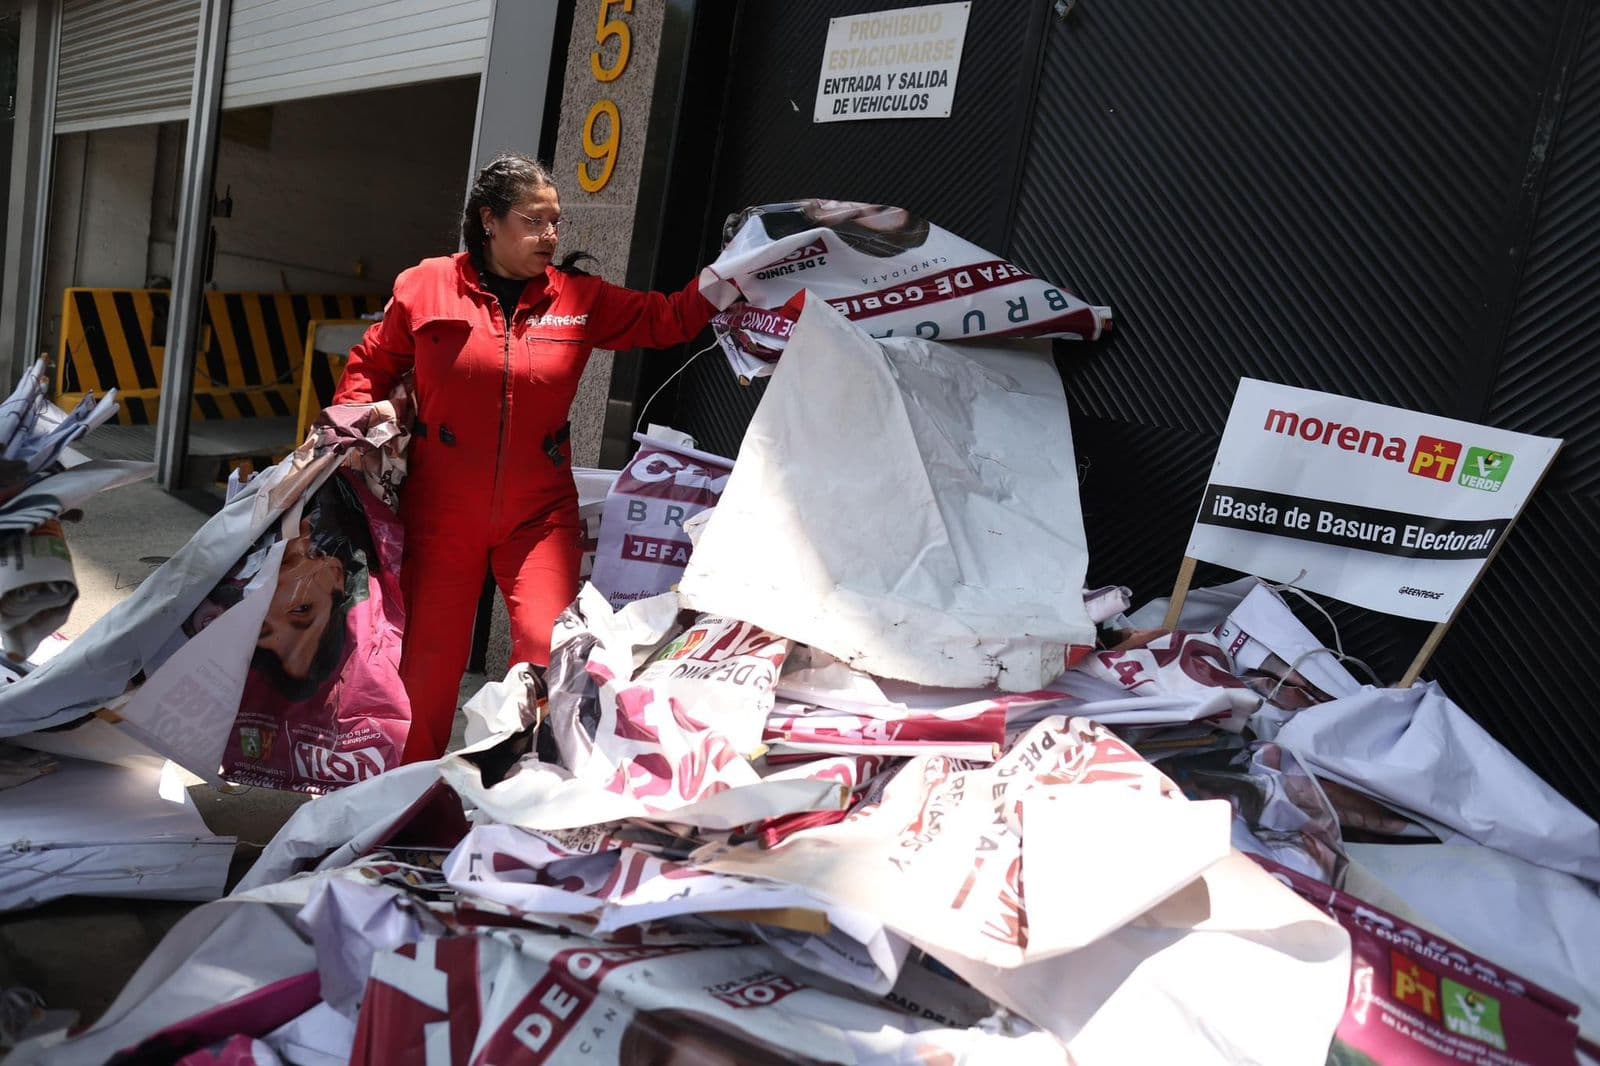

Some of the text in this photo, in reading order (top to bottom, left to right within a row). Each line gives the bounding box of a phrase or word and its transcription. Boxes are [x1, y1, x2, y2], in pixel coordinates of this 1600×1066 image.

[848, 11, 944, 42] PROHIBIDO
[828, 37, 957, 70] ESTACIONARSE
[823, 69, 948, 95] ENTRADA Y SALIDA
[832, 93, 930, 115] DE VEHICULOS
[756, 256, 827, 281] 2 DE JUNIO
[861, 257, 948, 285] CANDIDATA
[934, 271, 974, 296] DE
[525, 314, 589, 328] GREENPEACE
[740, 311, 781, 333] JUNIO
[1264, 408, 1501, 492] morena PT VERDE
[1212, 494, 1496, 552] ¡Basta de Basura Electoral!
[630, 540, 689, 563] JEFA
[1398, 585, 1445, 600] GREENPEACE
[342, 733, 382, 746] Candidatura
[1395, 970, 1437, 1016] PT
